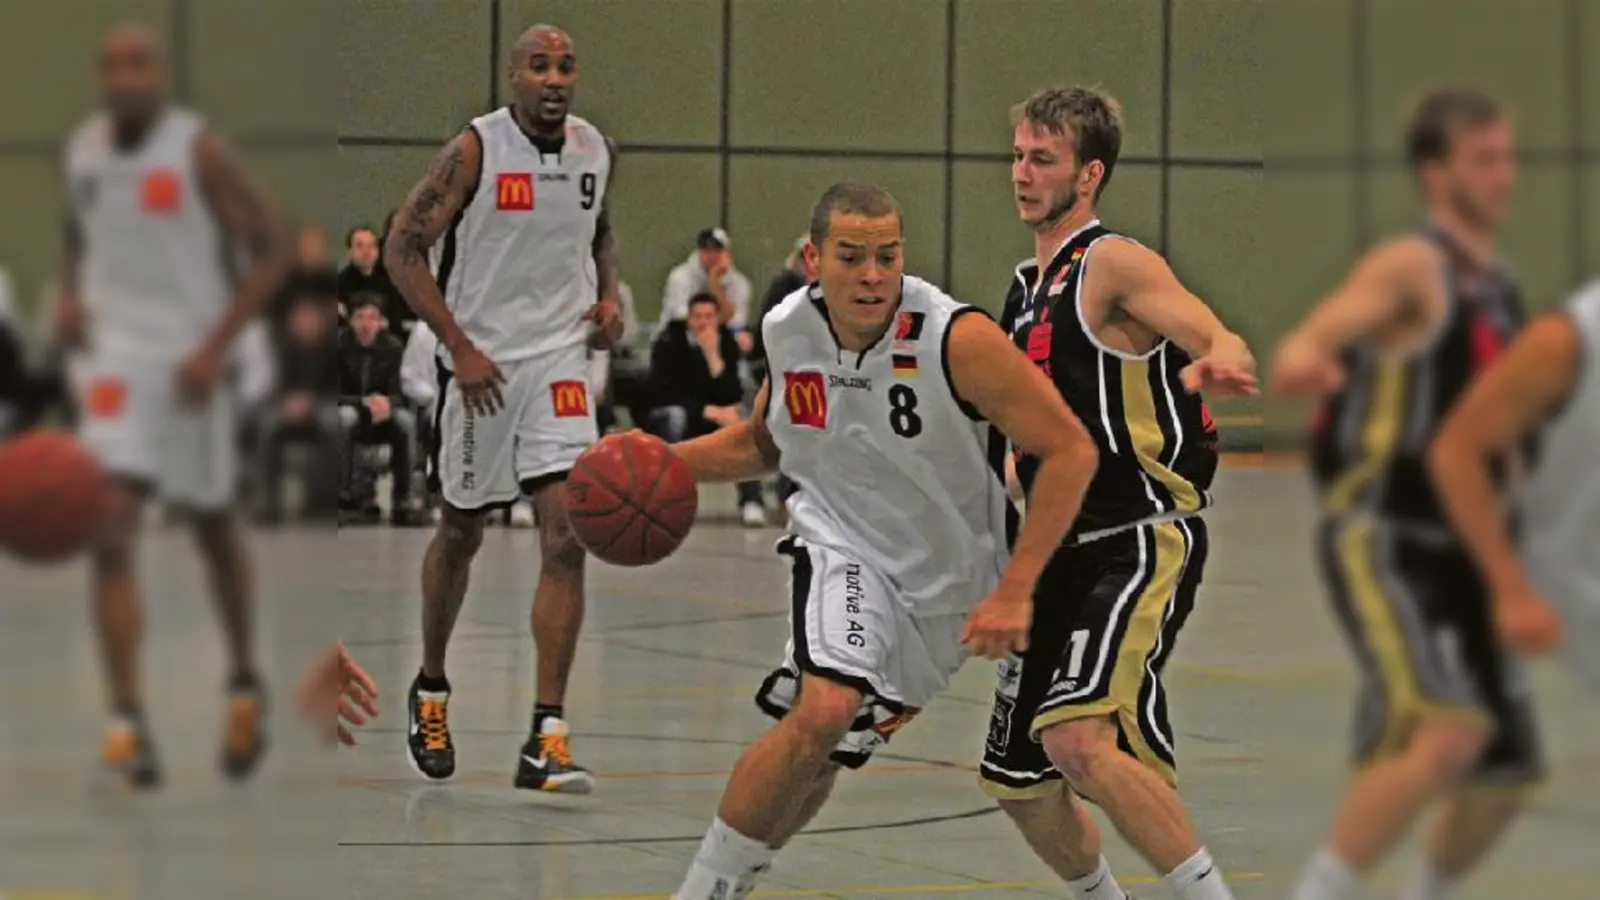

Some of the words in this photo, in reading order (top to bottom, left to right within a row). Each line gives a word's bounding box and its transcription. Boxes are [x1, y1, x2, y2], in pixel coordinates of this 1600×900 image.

[580, 172, 596, 210] 9
[888, 383, 922, 438] 8
[846, 619, 866, 648] AG
